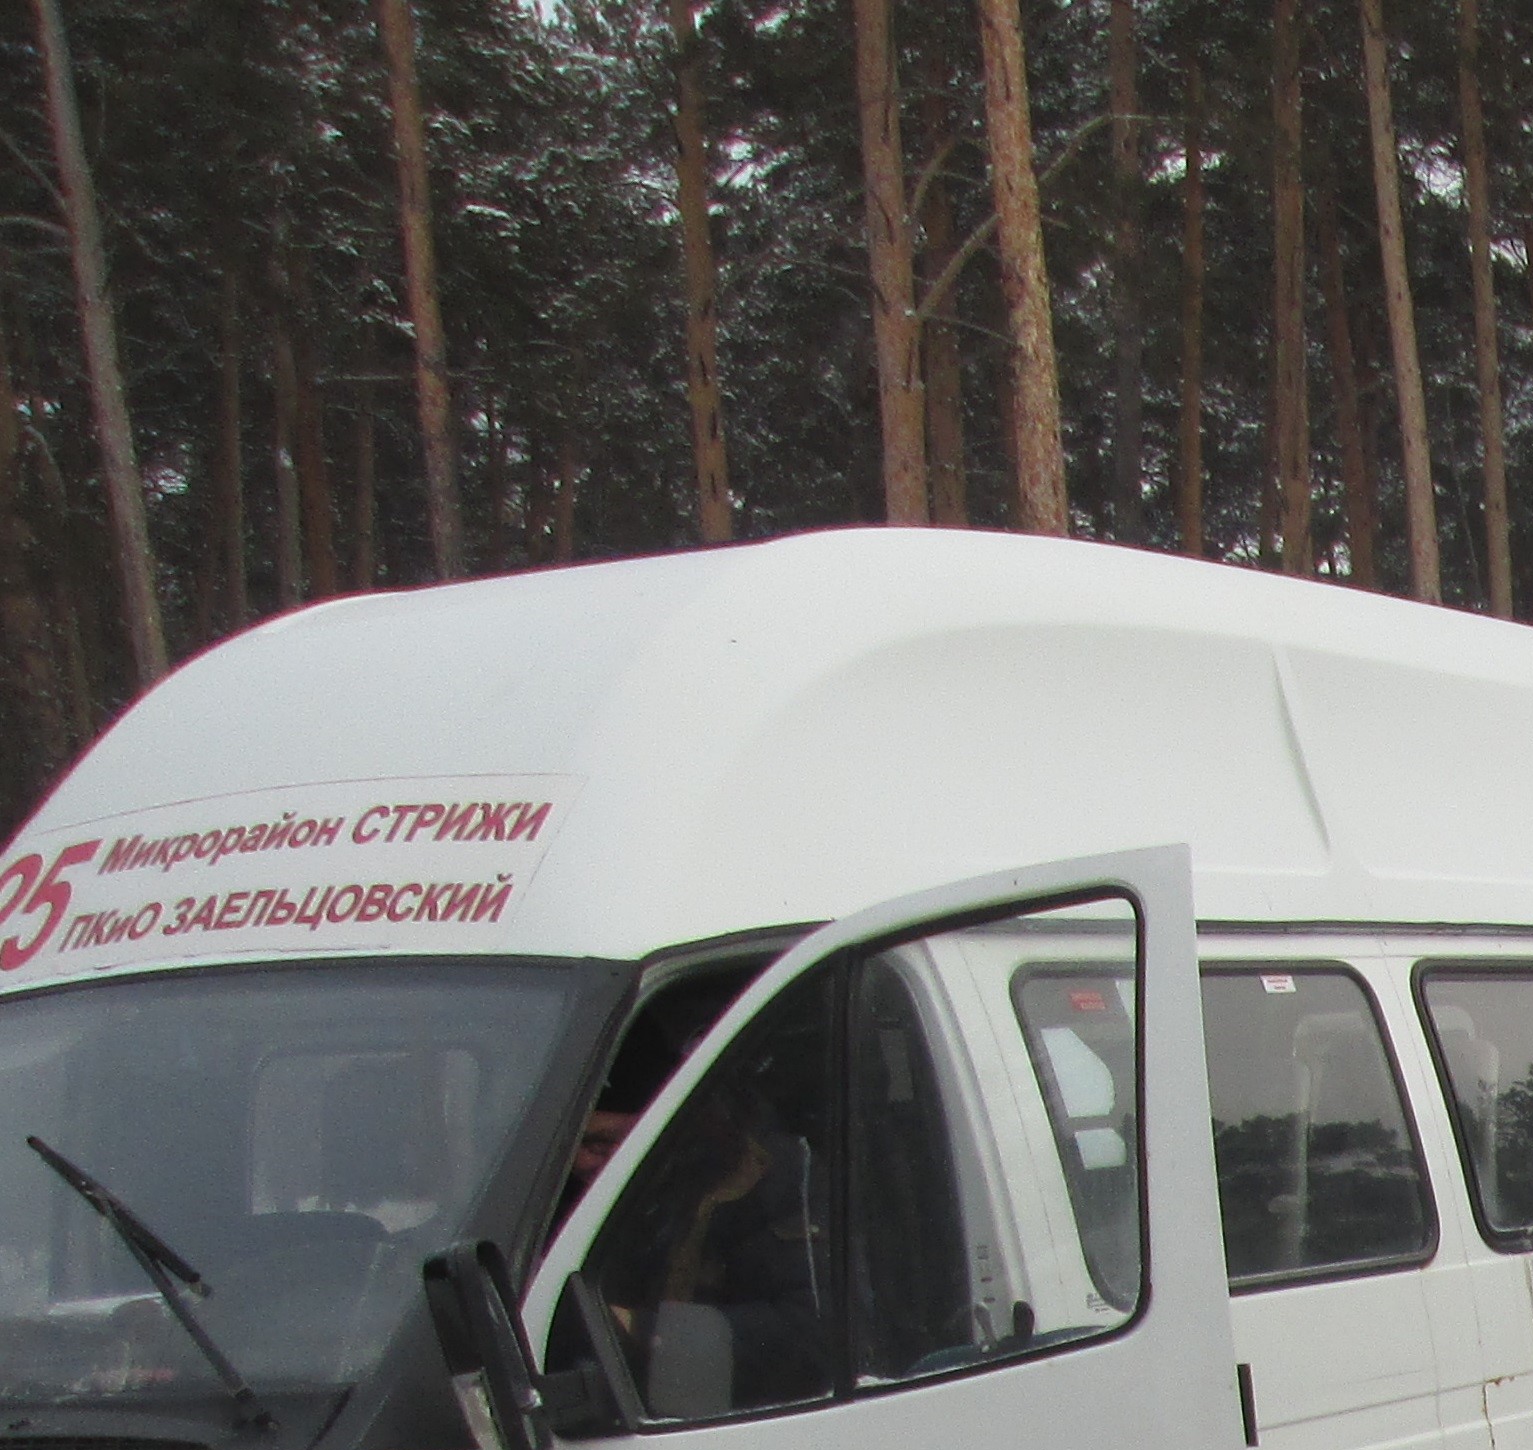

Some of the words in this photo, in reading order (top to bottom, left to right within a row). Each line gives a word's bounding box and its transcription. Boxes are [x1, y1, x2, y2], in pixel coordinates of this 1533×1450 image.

[98, 811, 346, 875] Микрорайон
[352, 802, 553, 845] СТРИЖИ
[58, 902, 164, 953] ПКиО
[162, 872, 514, 936] ЗАЕЛЬЦОВСКИЙ
